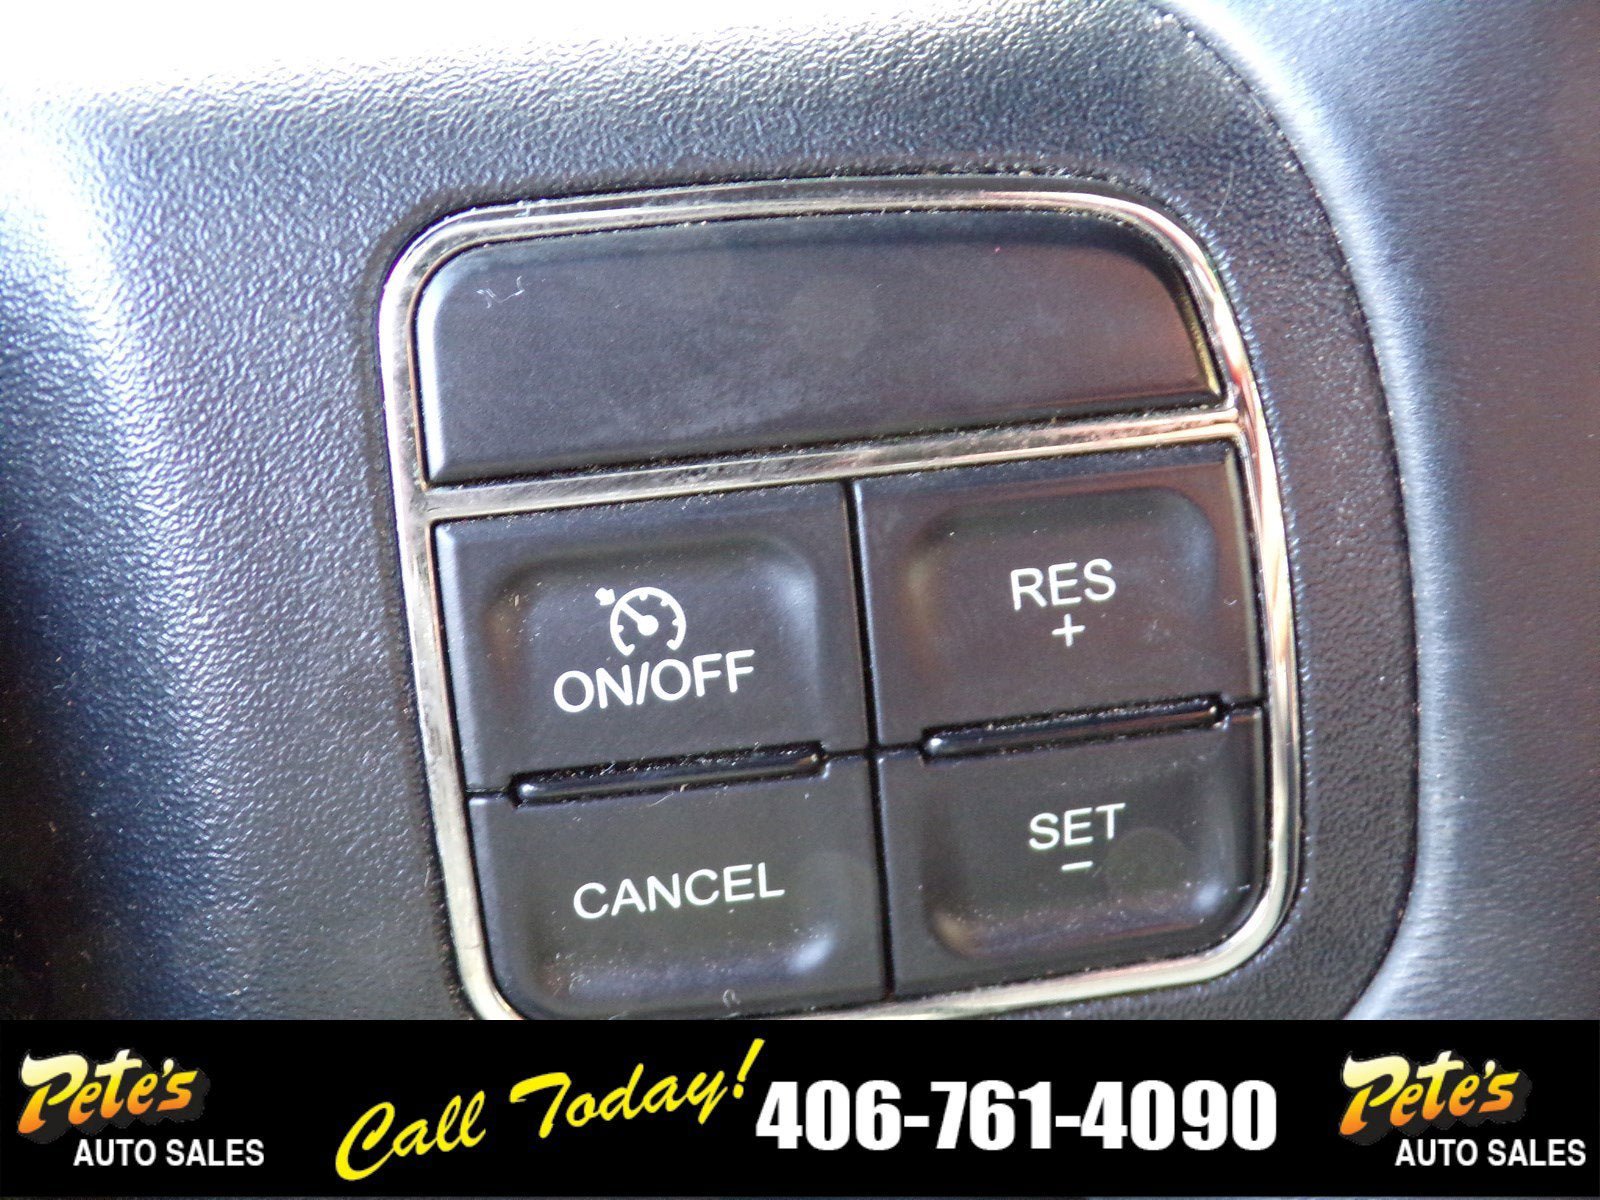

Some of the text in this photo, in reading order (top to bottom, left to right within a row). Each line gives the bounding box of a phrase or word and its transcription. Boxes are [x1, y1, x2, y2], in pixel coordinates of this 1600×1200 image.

[1009, 557, 1117, 612] RES
[553, 648, 756, 714] ON/OFF
[1028, 802, 1126, 851] SET
[572, 861, 786, 920] CANCEL
